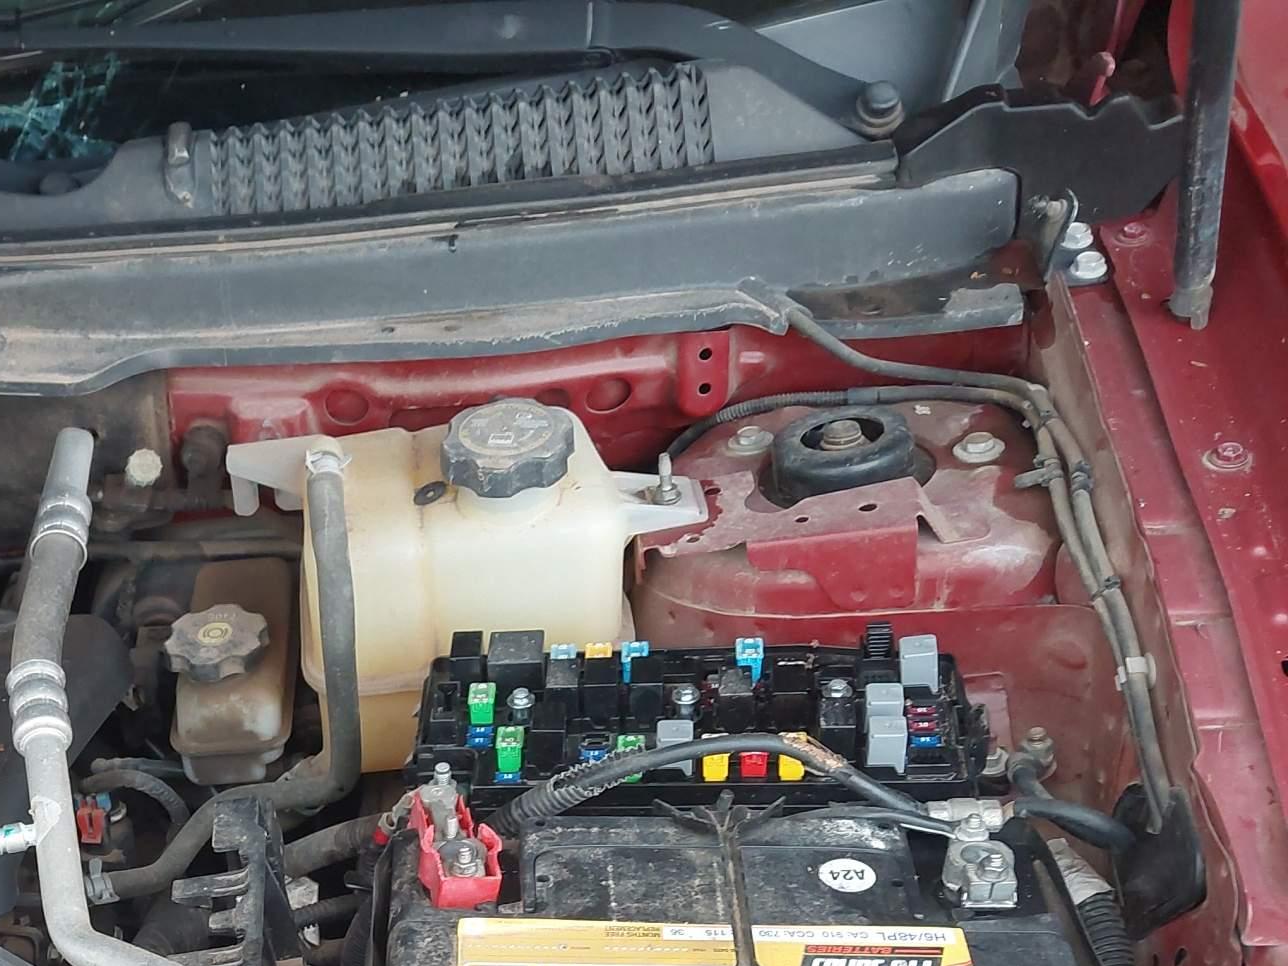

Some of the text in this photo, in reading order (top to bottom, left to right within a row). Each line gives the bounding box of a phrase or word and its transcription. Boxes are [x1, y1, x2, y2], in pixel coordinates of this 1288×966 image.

[829, 869, 865, 881] A24
[758, 929, 781, 937] 730
[806, 945, 894, 955] BATTERIES
